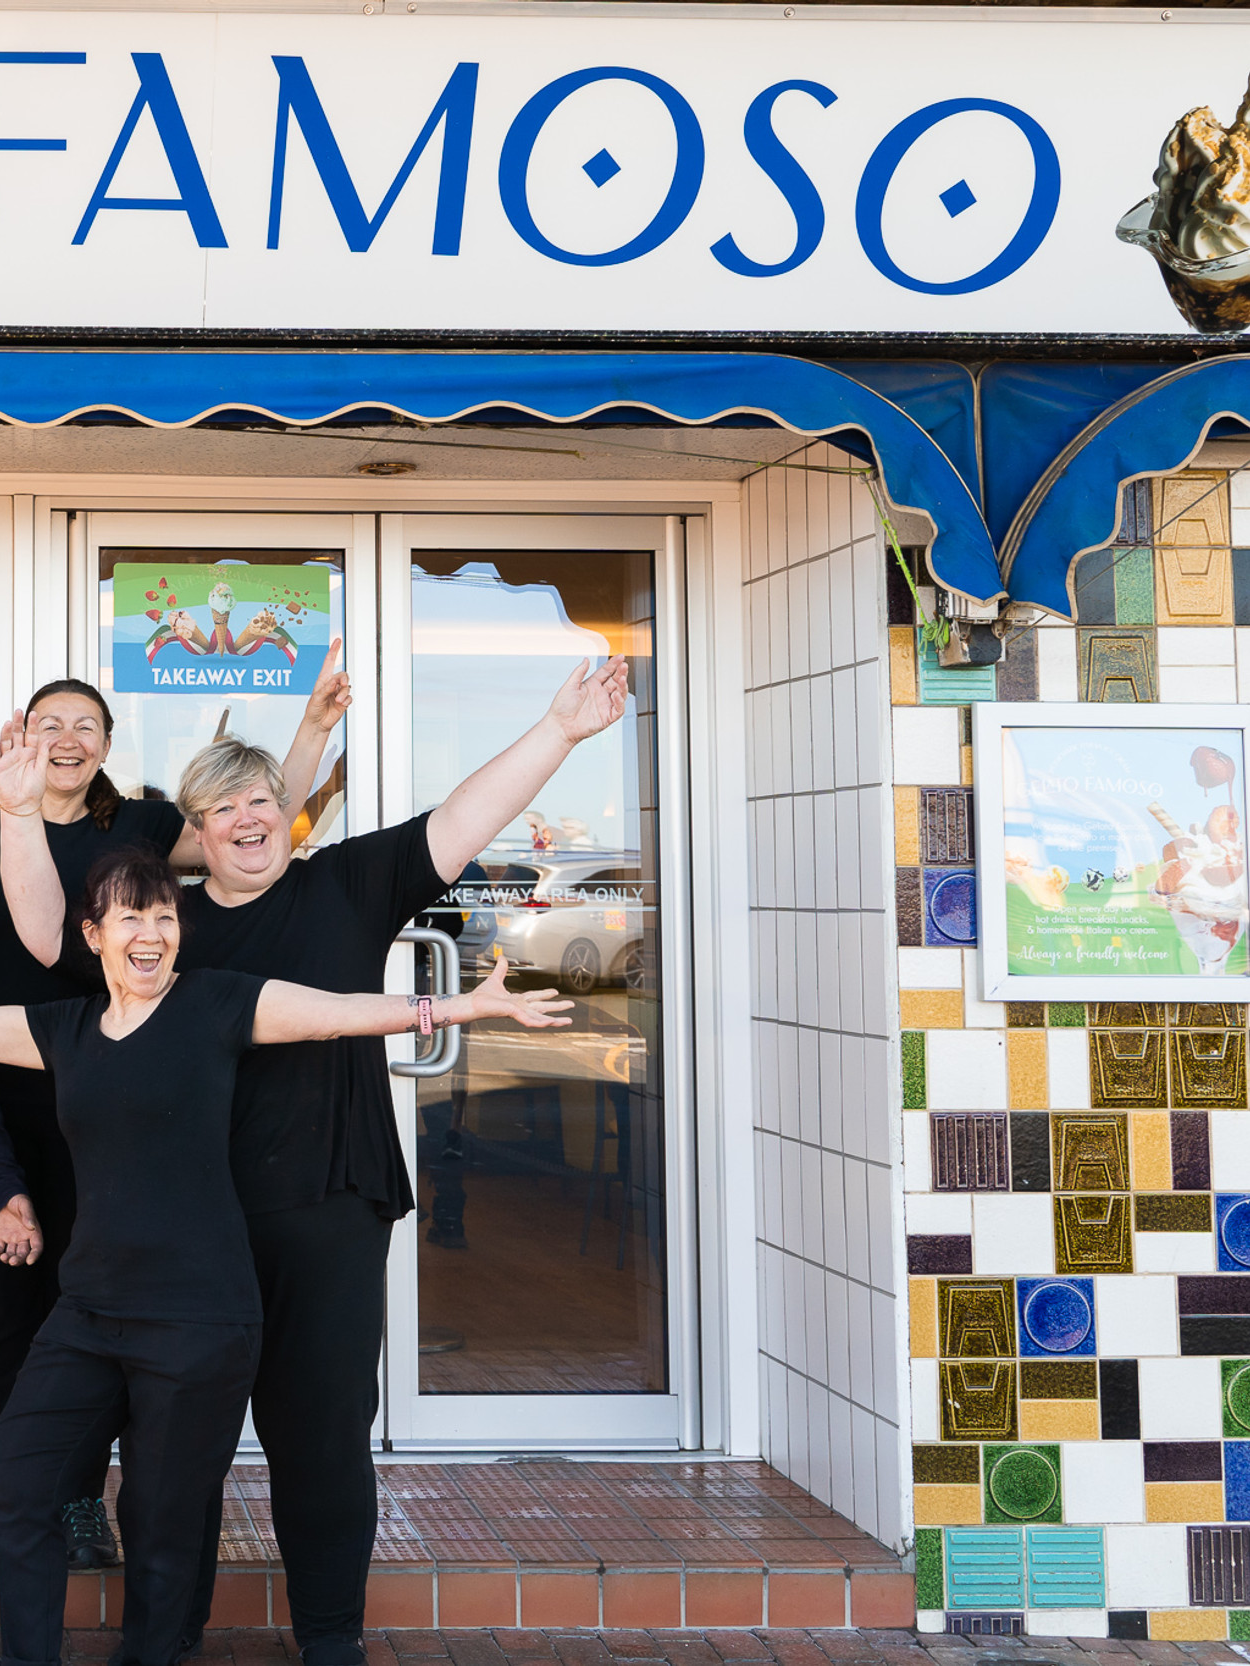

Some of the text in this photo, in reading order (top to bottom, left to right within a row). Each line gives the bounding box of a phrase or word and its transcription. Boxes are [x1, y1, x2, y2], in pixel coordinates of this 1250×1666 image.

[151, 667, 292, 687] TAKEAWAY EXIT
[1085, 776, 1164, 798] FAMOSO
[435, 887, 645, 903] AKE AWAY AREA ONLY
[1114, 925, 1127, 934] ice
[1016, 945, 1169, 966] Always a friendly welcome
